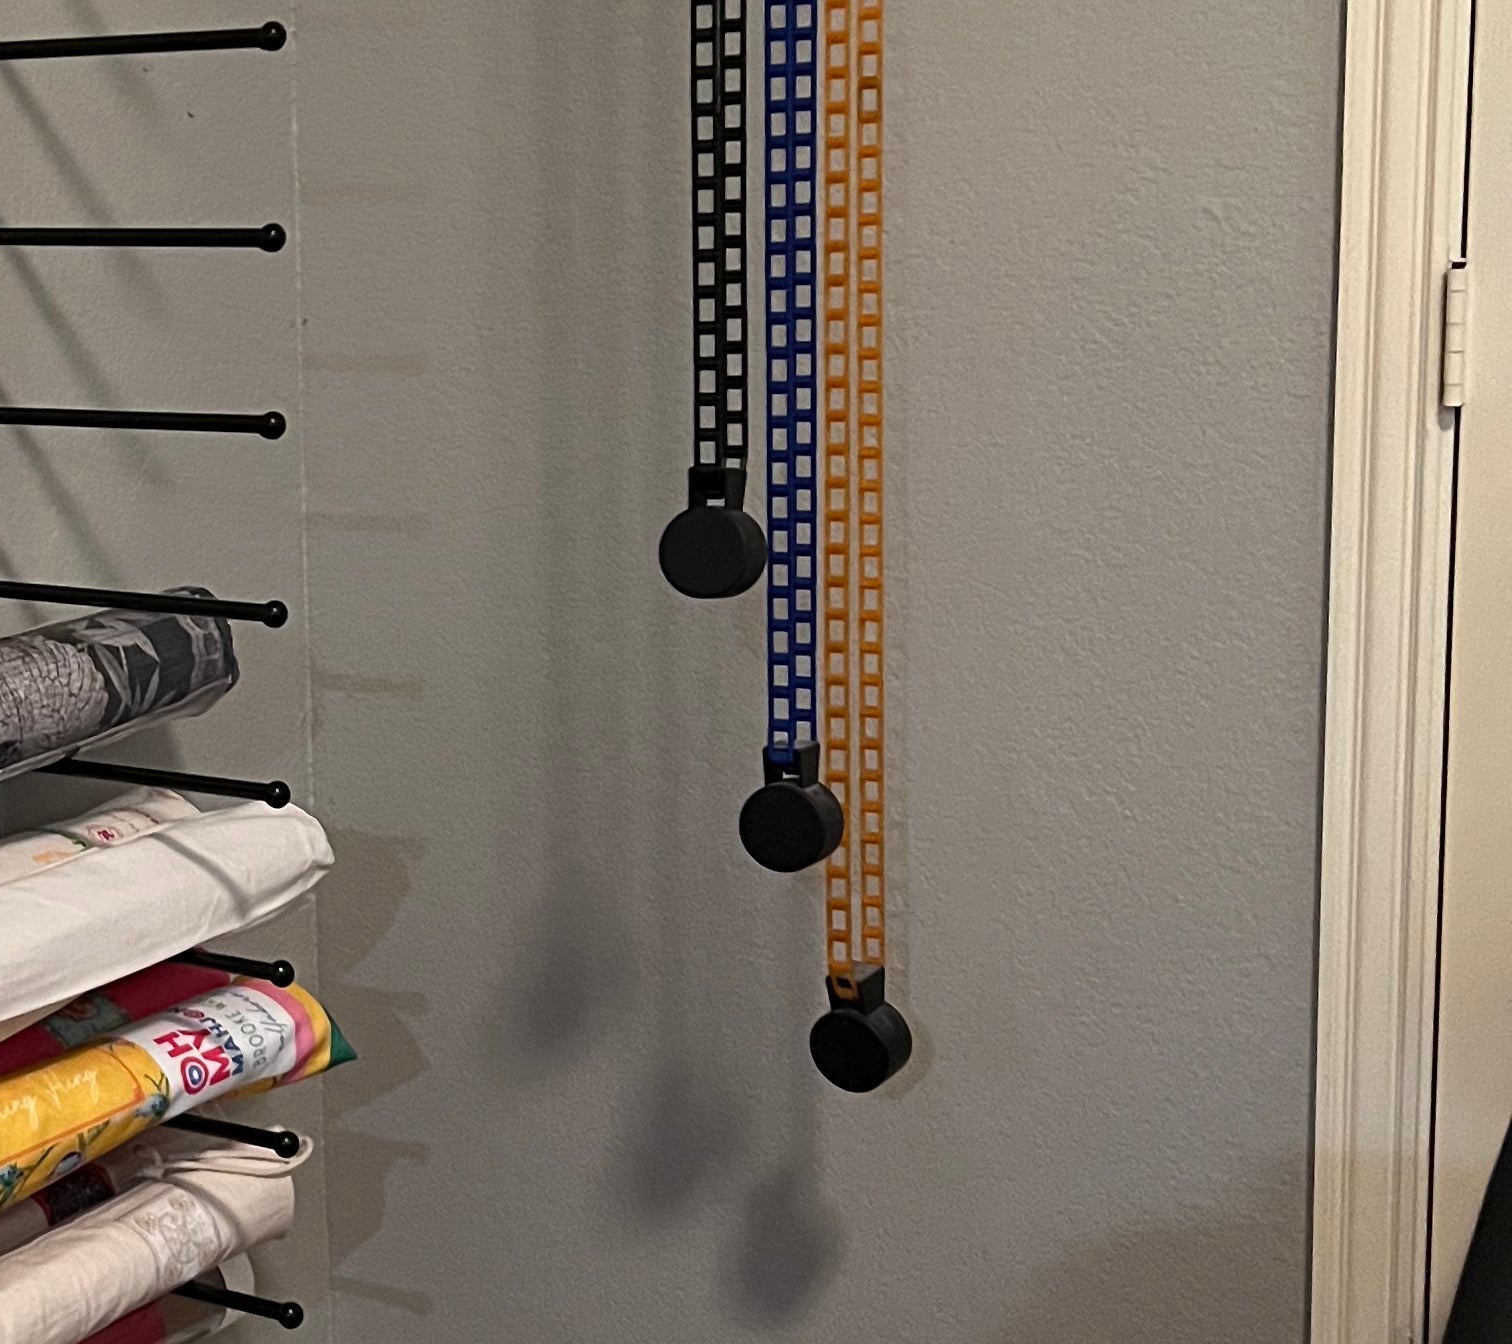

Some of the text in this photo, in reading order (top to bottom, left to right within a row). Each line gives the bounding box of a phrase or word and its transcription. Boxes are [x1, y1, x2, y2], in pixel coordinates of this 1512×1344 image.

[153, 1031, 210, 1095] OH
[172, 1006, 245, 1077] MAHJO
[177, 1028, 231, 1086] MY
